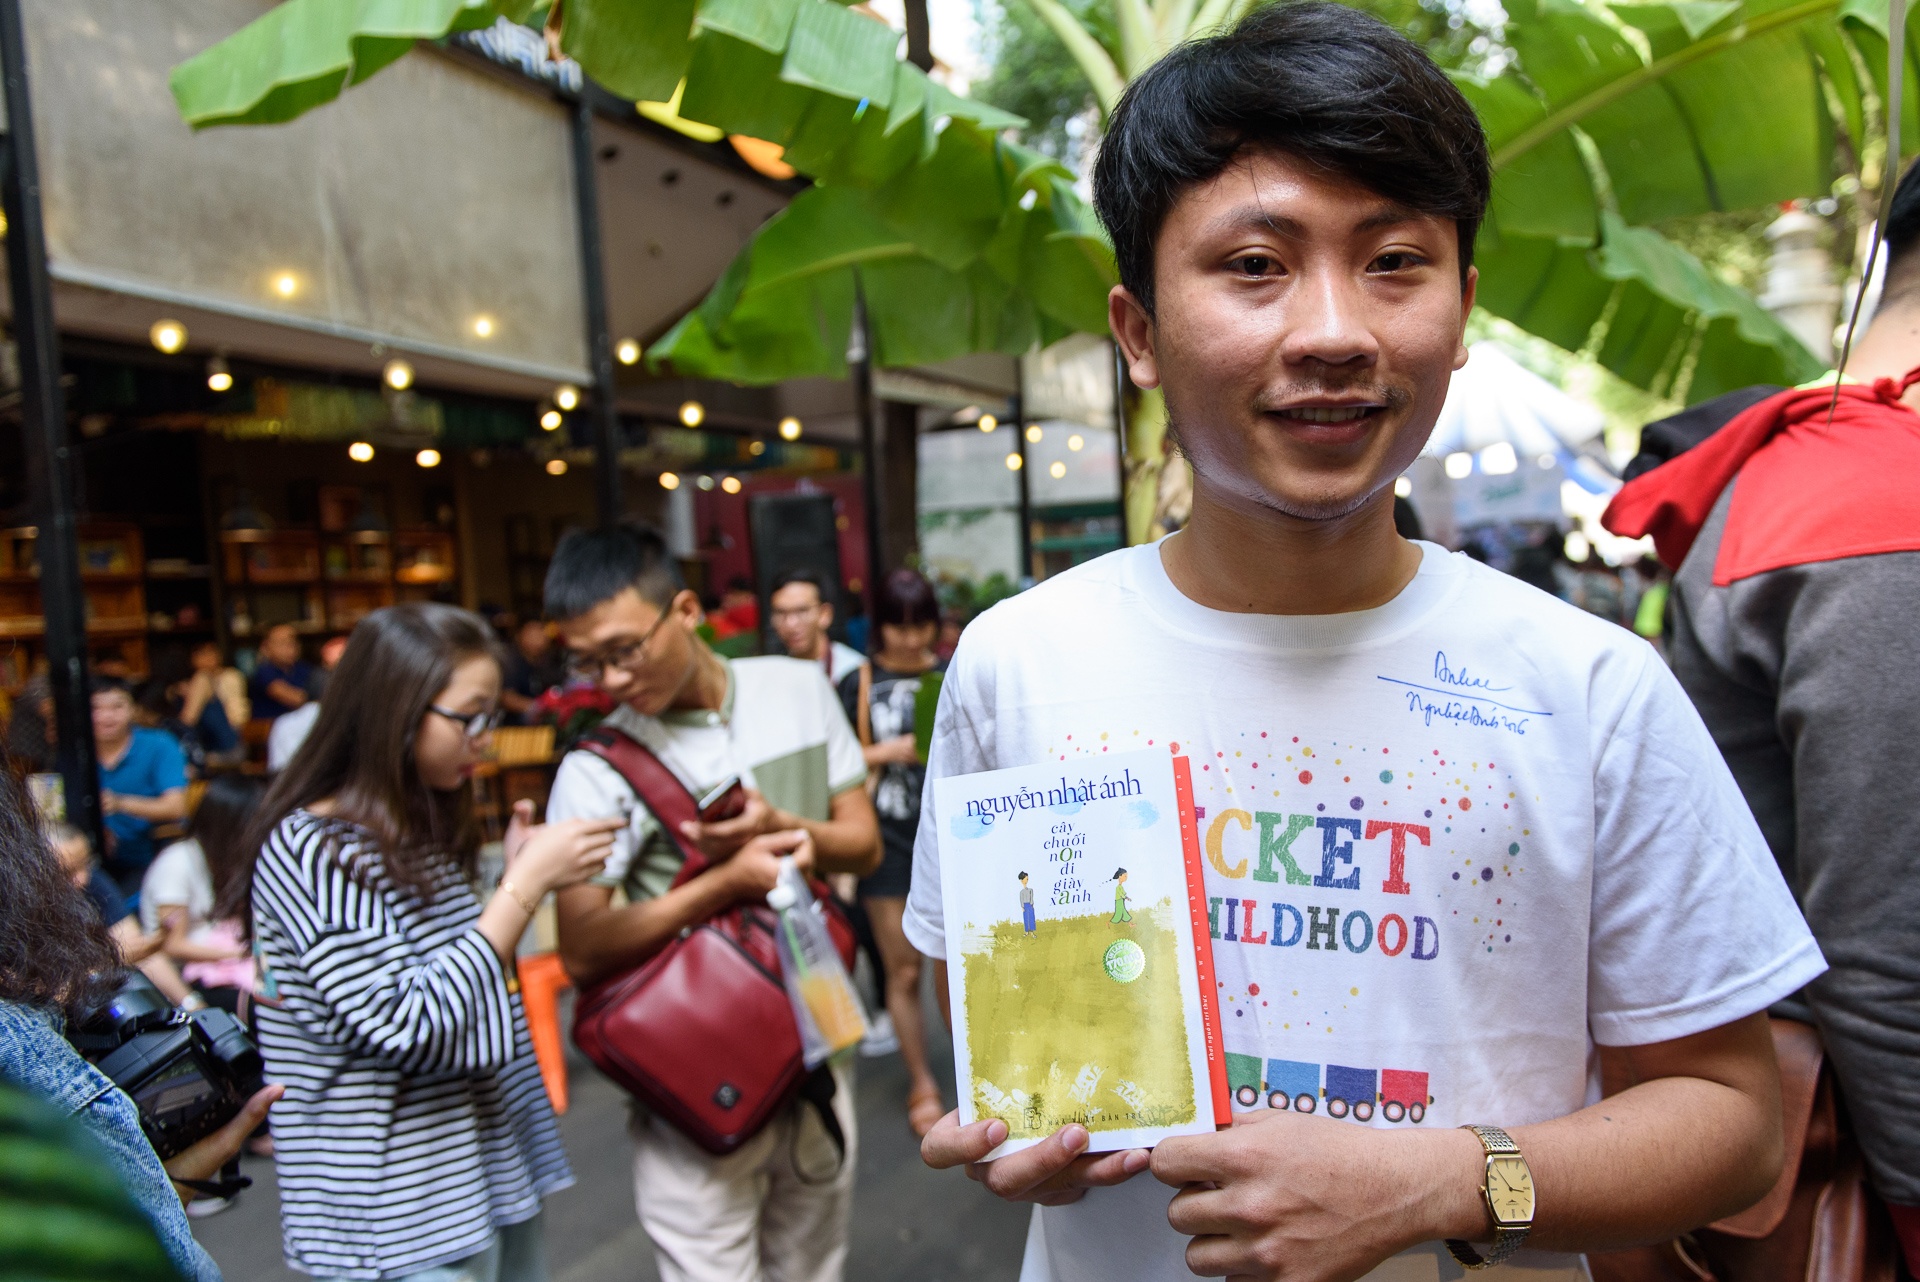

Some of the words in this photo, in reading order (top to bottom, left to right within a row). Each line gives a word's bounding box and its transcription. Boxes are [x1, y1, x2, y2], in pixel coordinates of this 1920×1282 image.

[966, 786, 1045, 825] nguyễn
[1047, 776, 1098, 806] nhật
[1099, 768, 1143, 801] ánh
[1194, 805, 1431, 895] CKET
[1049, 889, 1091, 906] xanh
